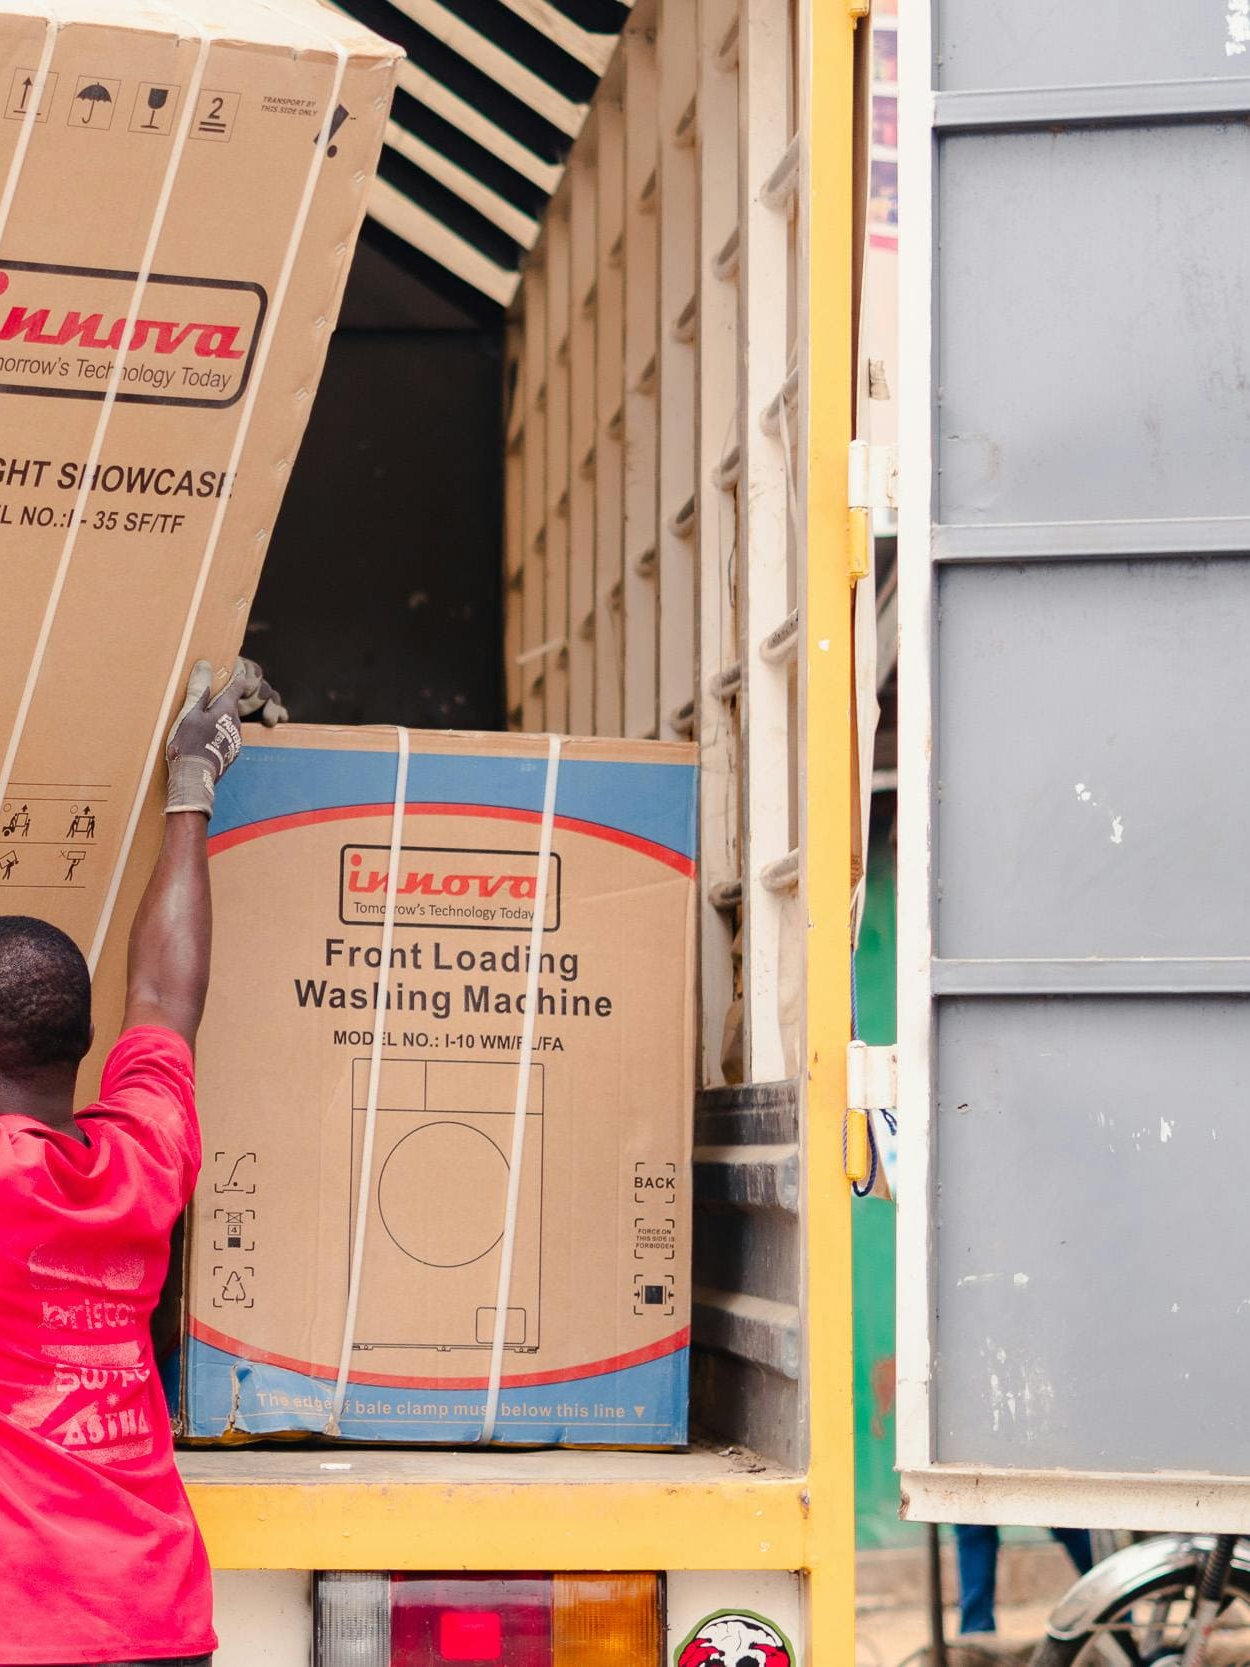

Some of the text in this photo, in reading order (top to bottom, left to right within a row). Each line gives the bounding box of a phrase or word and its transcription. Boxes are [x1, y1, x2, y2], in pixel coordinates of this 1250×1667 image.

[261, 104, 318, 117] THIS SIDE ONLY
[262, 96, 306, 107] TRANSPORT
[181, 367, 233, 392] Today
[93, 510, 118, 531] 35
[123, 512, 185, 535] SF/TF
[349, 854, 538, 899] innova
[428, 904, 496, 920] Technology
[500, 907, 534, 921] Today
[325, 938, 578, 982] Front Loading
[294, 979, 612, 1019] Washing Machine
[634, 1177, 675, 1189] BACK
[256, 1393, 290, 1408] The
[293, 1394, 332, 1411] edge
[355, 1401, 391, 1416] bale
[397, 1402, 449, 1418] clamp
[454, 1405, 488, 1417] mus
[501, 1403, 552, 1418] below
[557, 1403, 591, 1418] this
[594, 1404, 625, 1419] line
